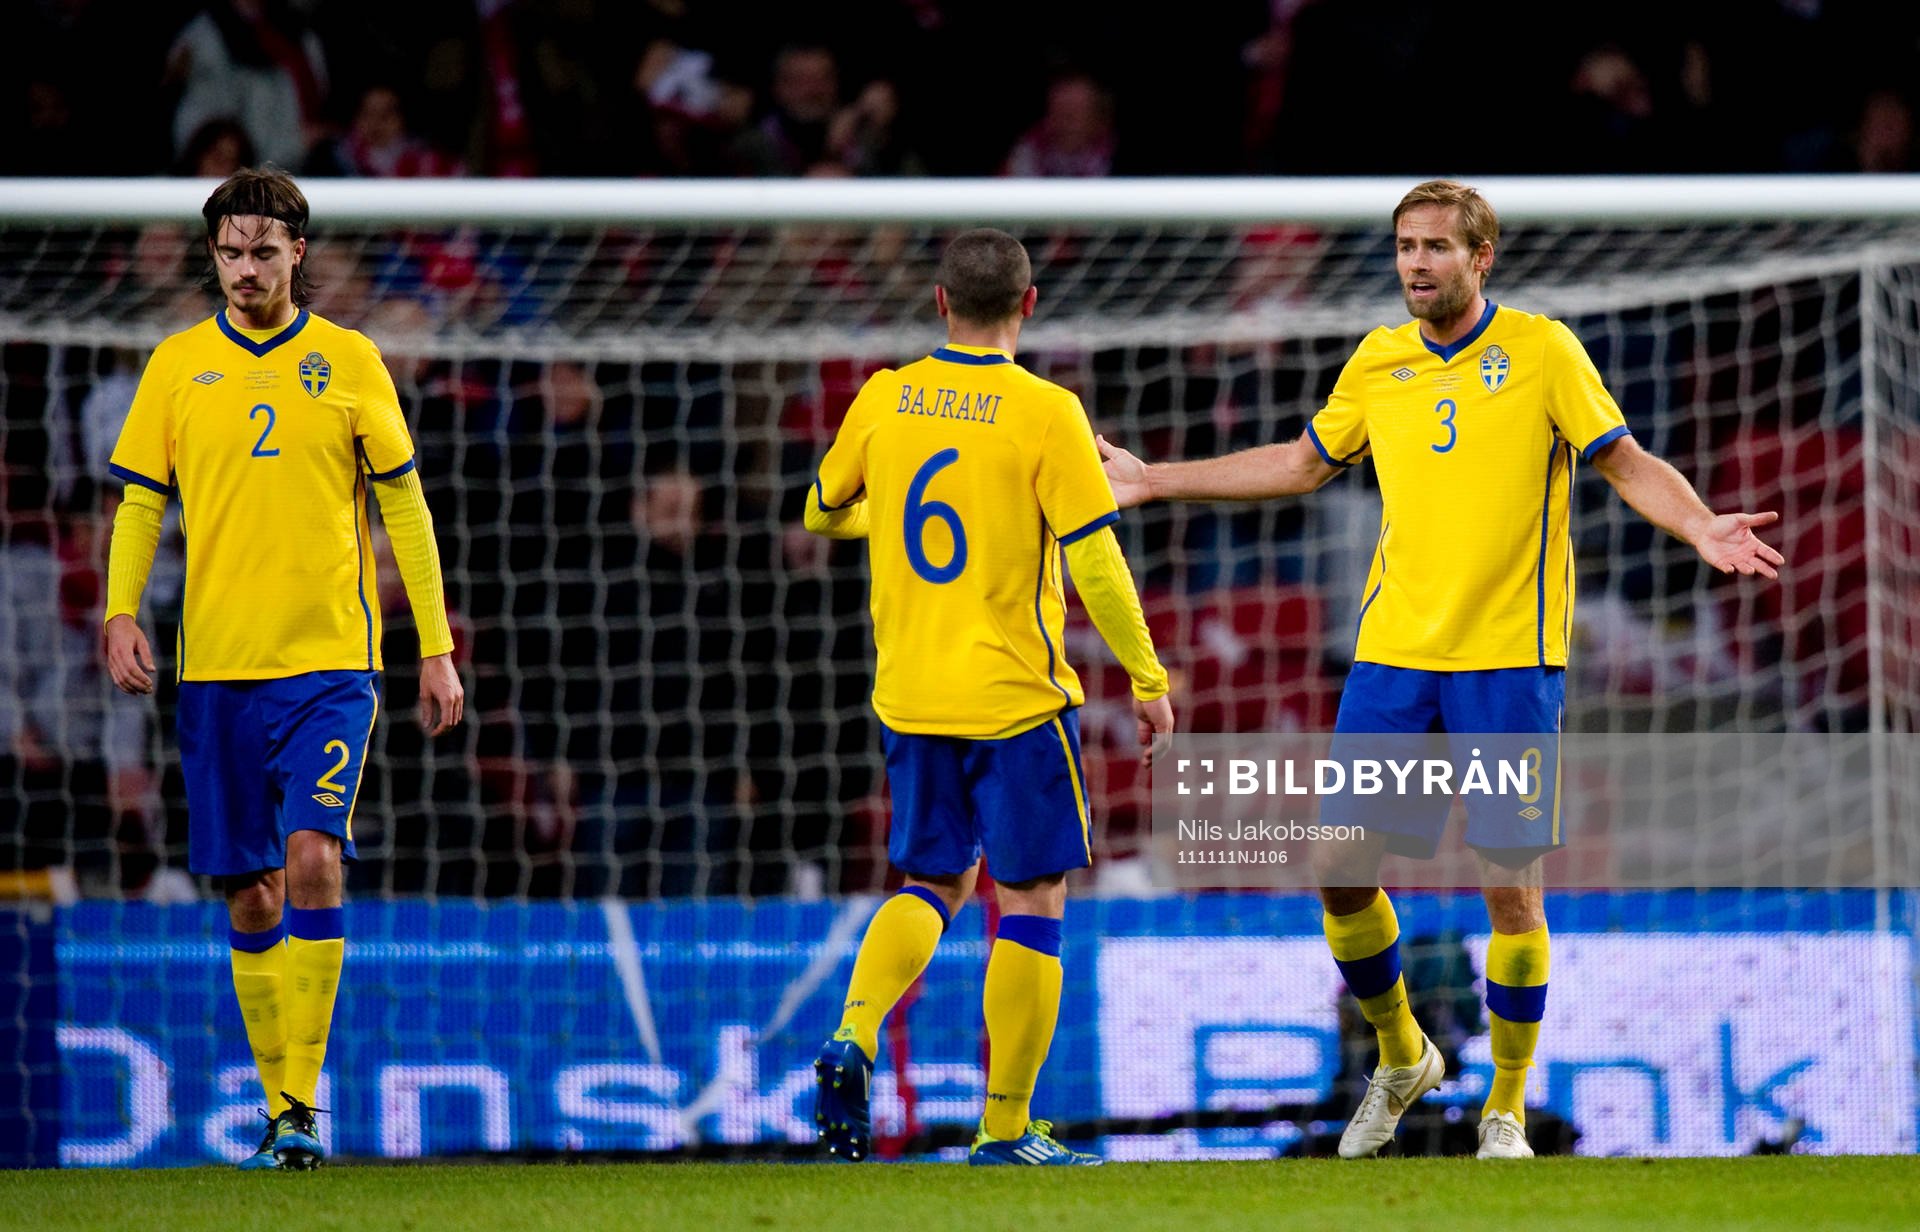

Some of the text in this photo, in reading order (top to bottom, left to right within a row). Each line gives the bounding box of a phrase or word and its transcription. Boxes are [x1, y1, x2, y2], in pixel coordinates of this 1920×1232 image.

[249, 403, 280, 458] 2
[897, 384, 1003, 425] BAJRAMI
[1431, 398, 1457, 453] 3
[903, 447, 968, 585] 6
[316, 739, 350, 794] 2
[1519, 747, 1542, 804] 3
